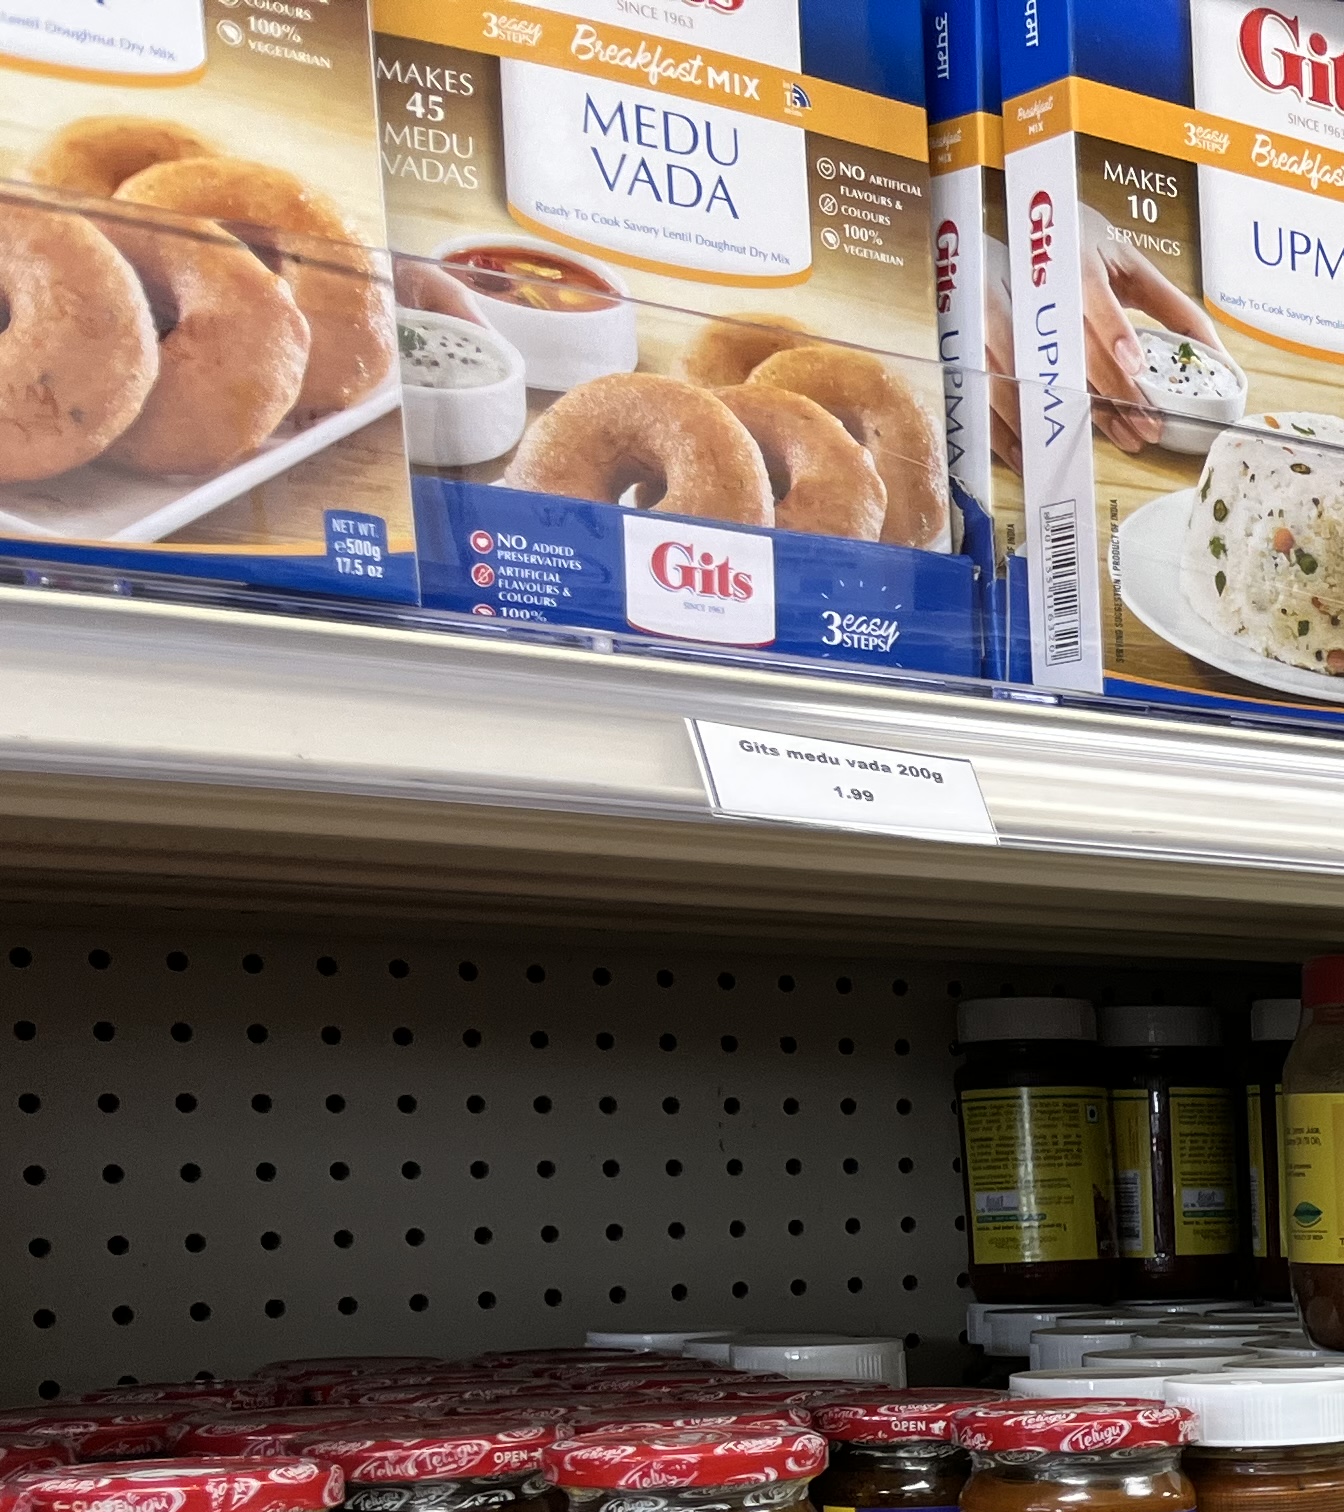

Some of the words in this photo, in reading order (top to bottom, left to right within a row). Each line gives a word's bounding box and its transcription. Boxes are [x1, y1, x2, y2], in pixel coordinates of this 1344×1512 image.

[377, 57, 475, 97] MAKES
[571, 25, 703, 86] Breakfast
[707, 69, 760, 101] MIX
[406, 95, 445, 122] 45
[385, 124, 474, 159] MEDU
[582, 92, 739, 168] MEDU
[381, 154, 478, 190] VADAS
[591, 146, 740, 220] VADA
[1103, 160, 1178, 198] MAKES
[1127, 195, 1158, 223] 10
[1029, 190, 1055, 288] Gits
[1106, 225, 1181, 257] SERVINGS
[937, 219, 960, 315] Gits
[650, 541, 754, 603] Gits
[739, 739, 781, 757] Gits
[786, 745, 841, 769] medu
[845, 753, 893, 776] vada
[896, 762, 945, 785] 200g
[833, 786, 876, 803] 1.99
[891, 1418, 927, 1433] OPEN
